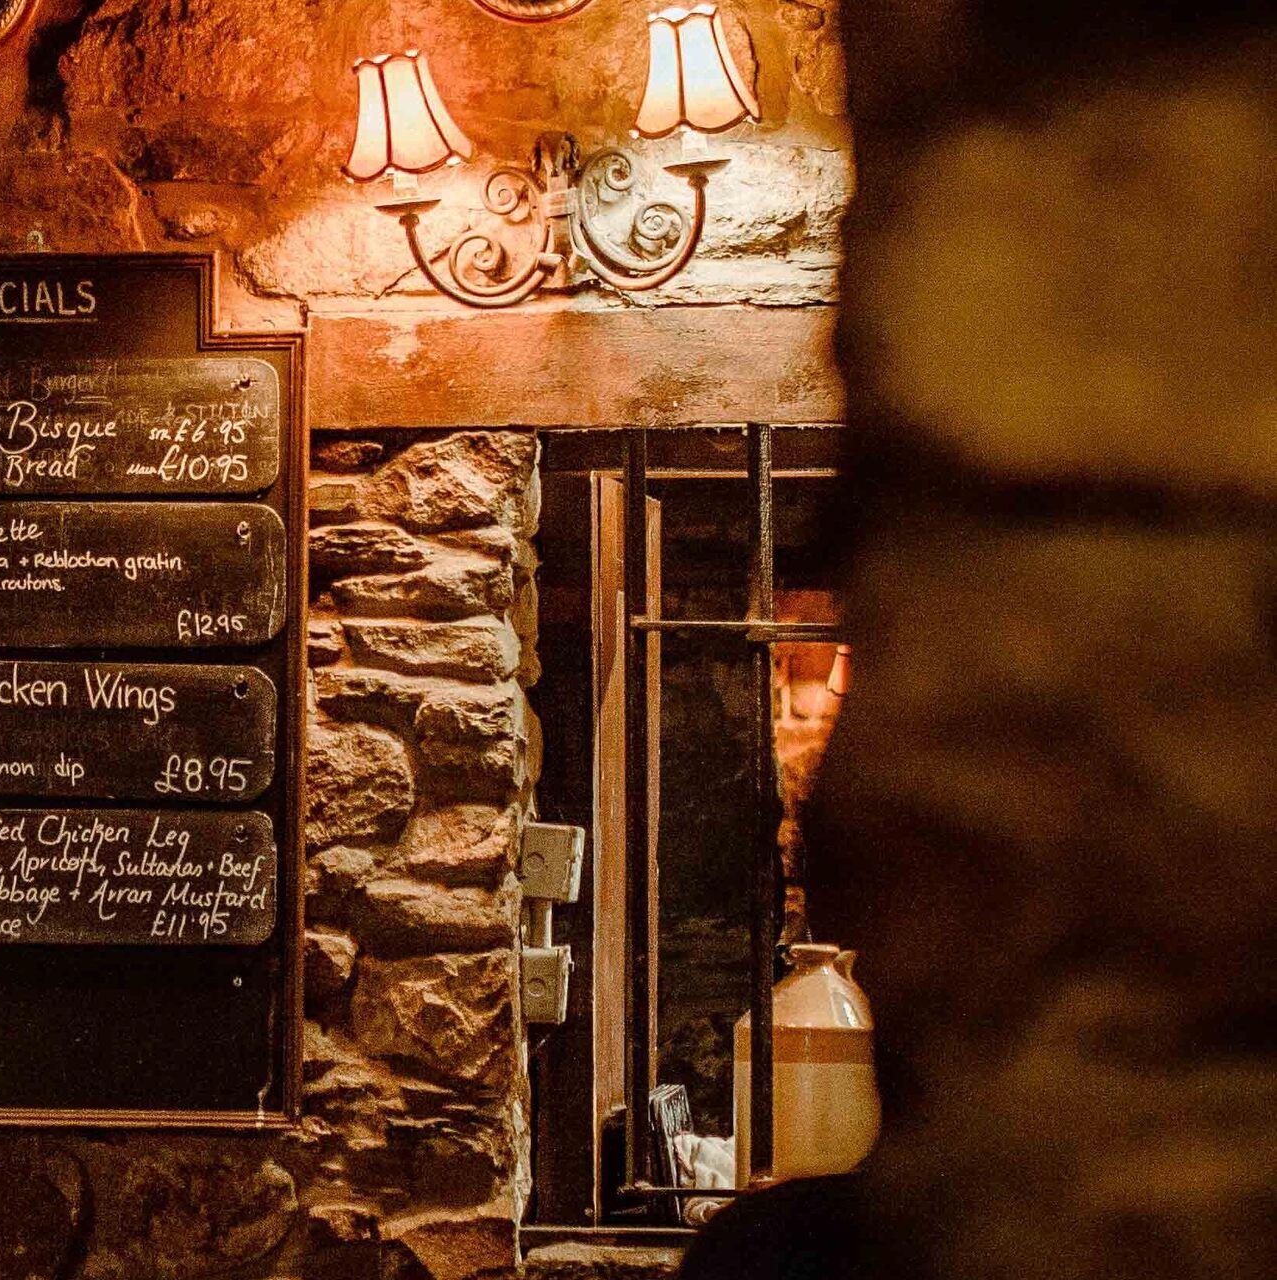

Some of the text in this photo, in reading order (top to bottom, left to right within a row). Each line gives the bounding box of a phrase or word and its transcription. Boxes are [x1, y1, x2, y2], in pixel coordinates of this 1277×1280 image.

[0, 401, 118, 458] Bisque
[4, 454, 78, 487] Bread
[34, 550, 119, 569] Reblochon
[125, 553, 182, 580] gratin
[178, 609, 248, 640] £12.95
[84, 668, 177, 725] Wings
[54, 752, 85, 786] dip
[154, 754, 254, 793] £8.95
[38, 815, 130, 862] Chicken
[147, 816, 190, 863] Leg
[218, 853, 266, 891] Beef
[88, 879, 152, 920] Arran
[161, 880, 266, 920] Mustard
